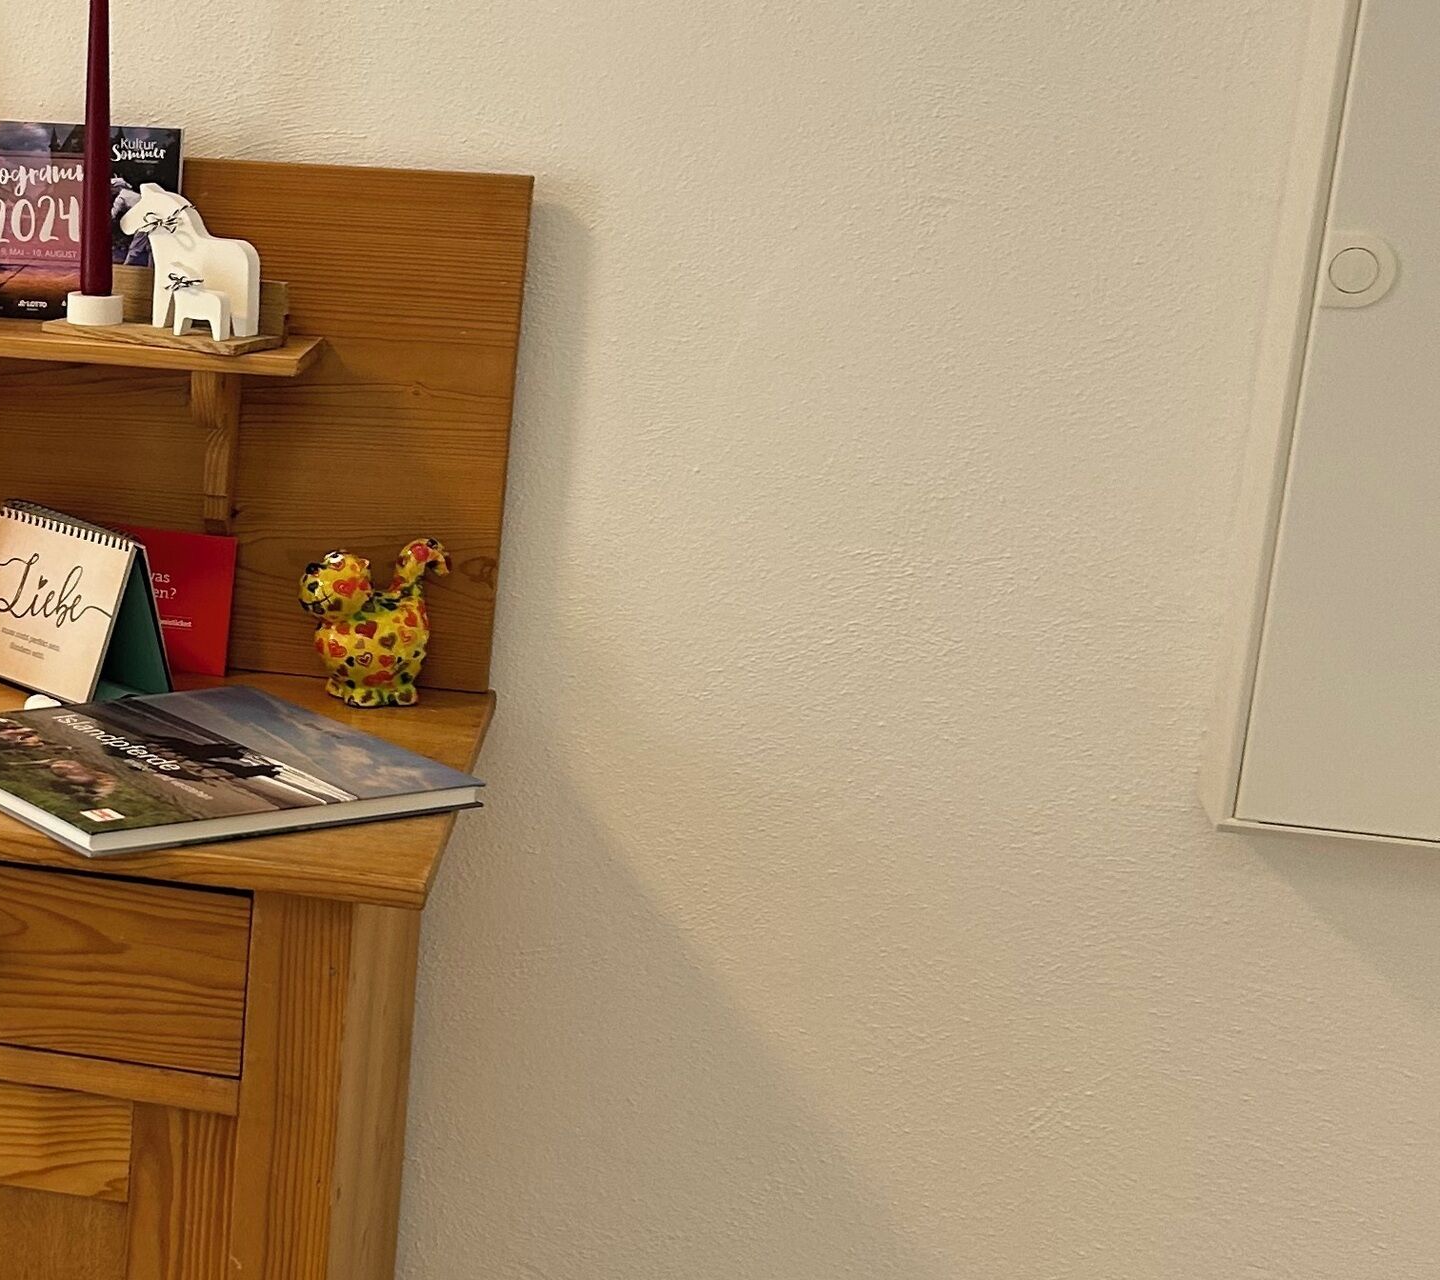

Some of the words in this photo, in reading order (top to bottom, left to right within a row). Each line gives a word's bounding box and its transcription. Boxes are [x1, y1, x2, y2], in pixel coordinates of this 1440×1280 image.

[120, 137, 157, 150] Kultur
[110, 144, 166, 162] Sommer
[9, 248, 26, 257] MAI
[45, 248, 77, 259] AUGUST
[52, 714, 181, 771] Islandpferde
